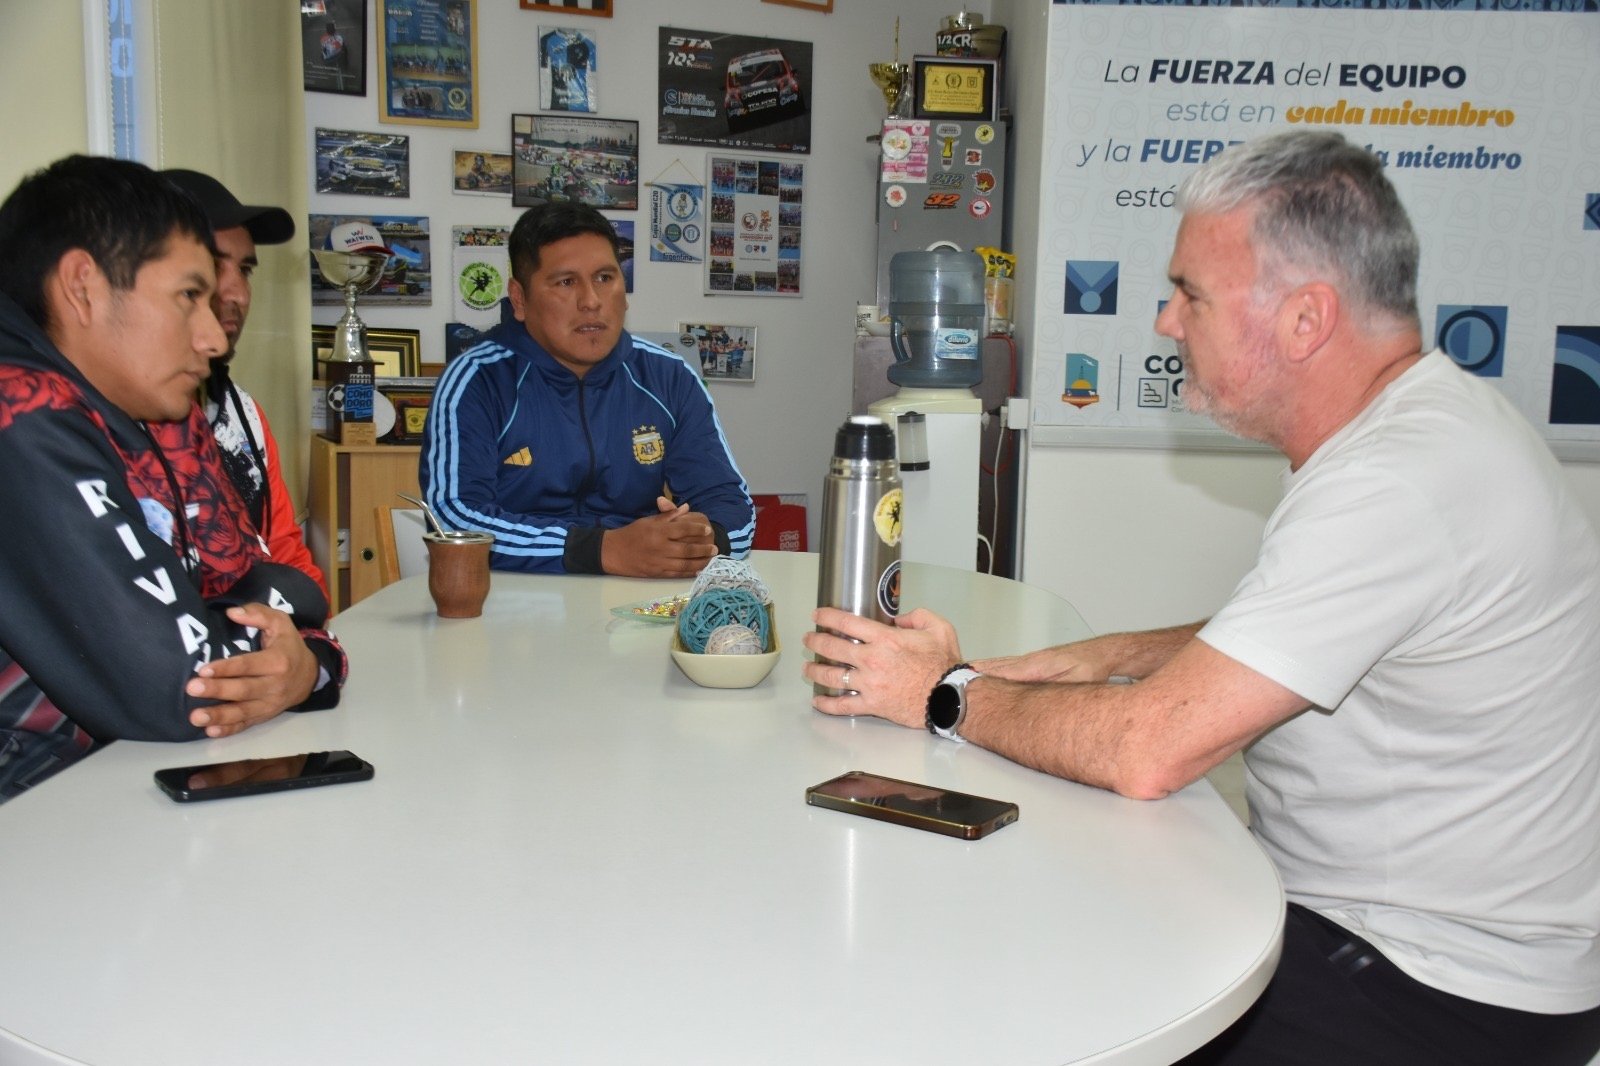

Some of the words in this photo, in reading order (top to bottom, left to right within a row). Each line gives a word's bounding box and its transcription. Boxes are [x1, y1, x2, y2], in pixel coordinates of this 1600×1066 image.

[1105, 59, 1140, 84] La
[1149, 59, 1275, 86] FUERZA
[1284, 62, 1331, 87] del
[1339, 64, 1467, 92] EQUIPO
[1166, 98, 1229, 123] está
[1239, 103, 1275, 124] en
[1286, 100, 1363, 126] cada
[1370, 101, 1514, 128] miembro
[1076, 144, 1098, 168] y
[1105, 139, 1130, 163] la
[1140, 139, 1246, 165] FUER
[1397, 145, 1523, 170] miembro
